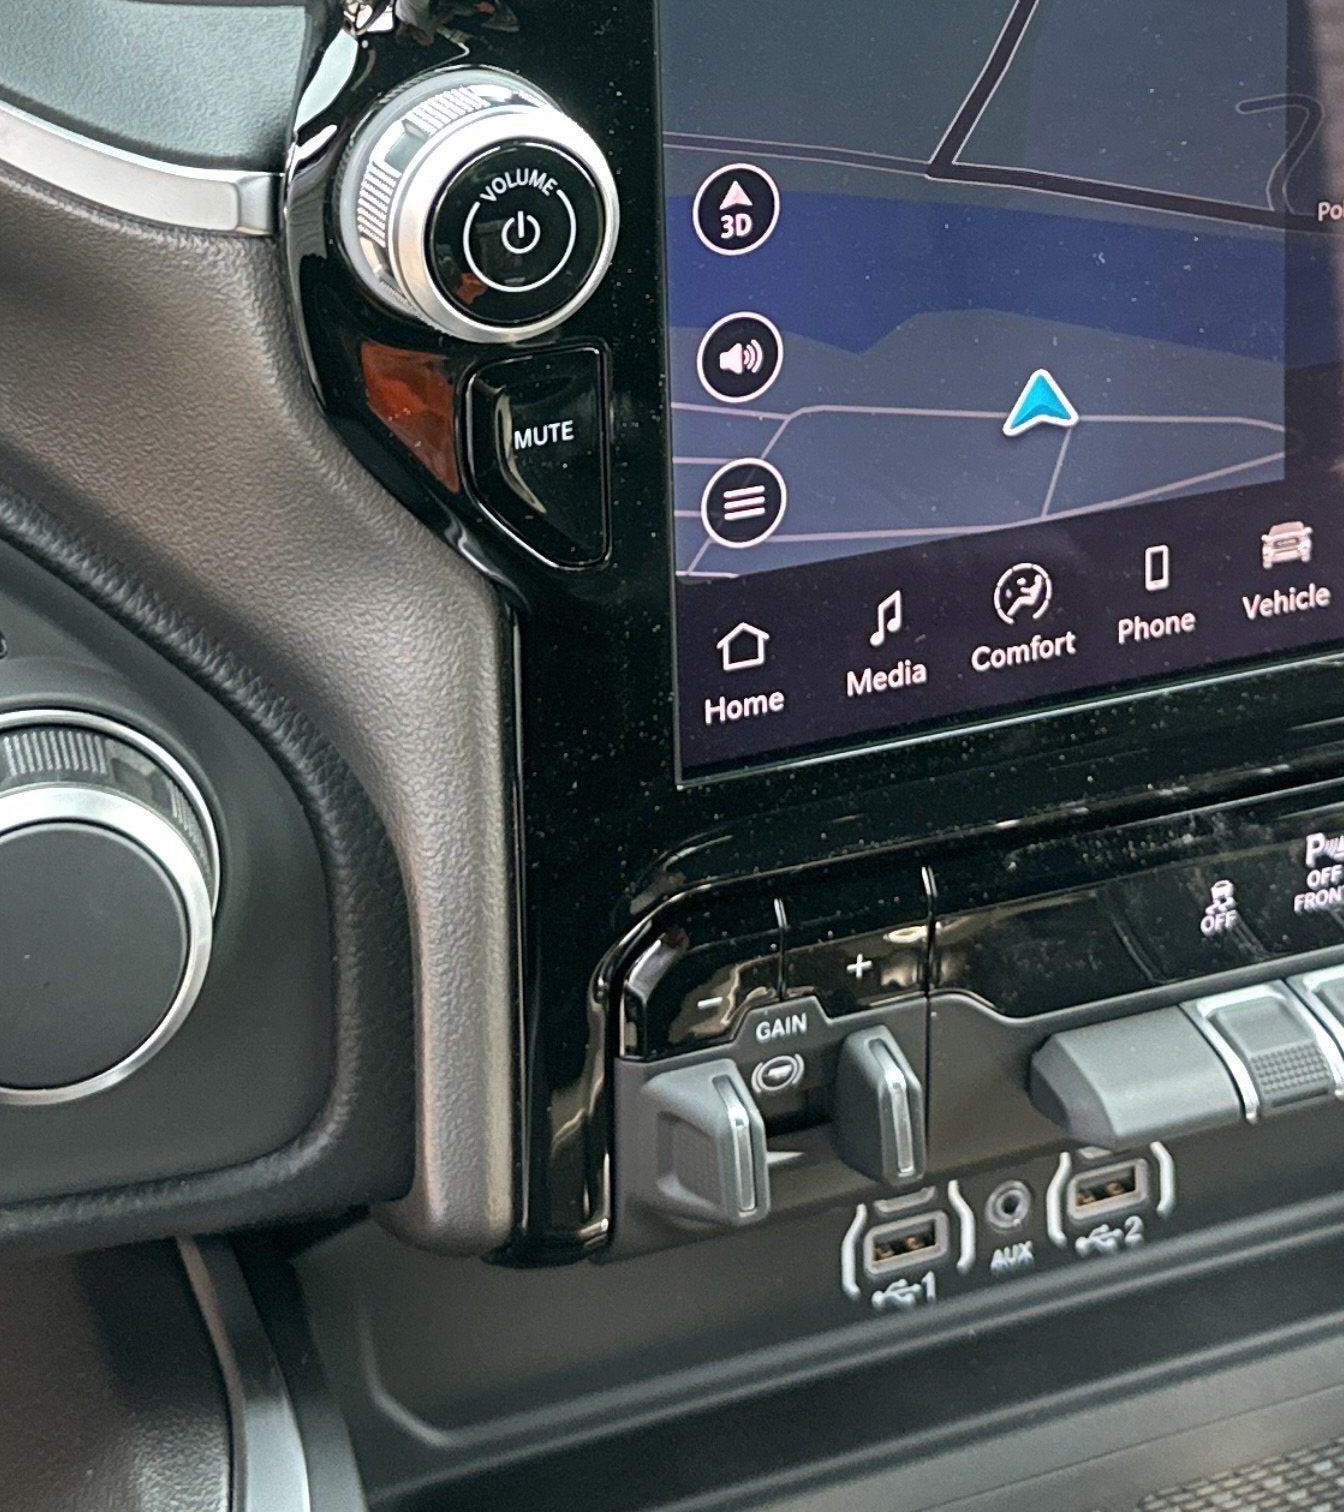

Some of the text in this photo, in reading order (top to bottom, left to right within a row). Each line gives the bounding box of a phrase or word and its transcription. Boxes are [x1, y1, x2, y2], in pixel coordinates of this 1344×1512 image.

[481, 169, 558, 202] VOLUME
[720, 214, 752, 239] 3D
[514, 420, 574, 451] MUTE
[1243, 583, 1331, 620] Vehicle
[1118, 610, 1196, 645] Phone
[971, 631, 1076, 673] Comfort
[846, 660, 927, 697] Media
[704, 691, 785, 725] Home
[1306, 866, 1344, 889] OFF
[1201, 910, 1237, 936] OFF
[756, 1012, 807, 1041] GAIN
[1125, 1216, 1144, 1243] 2
[990, 1242, 1034, 1272] AUX
[924, 1271, 937, 1304] 1
